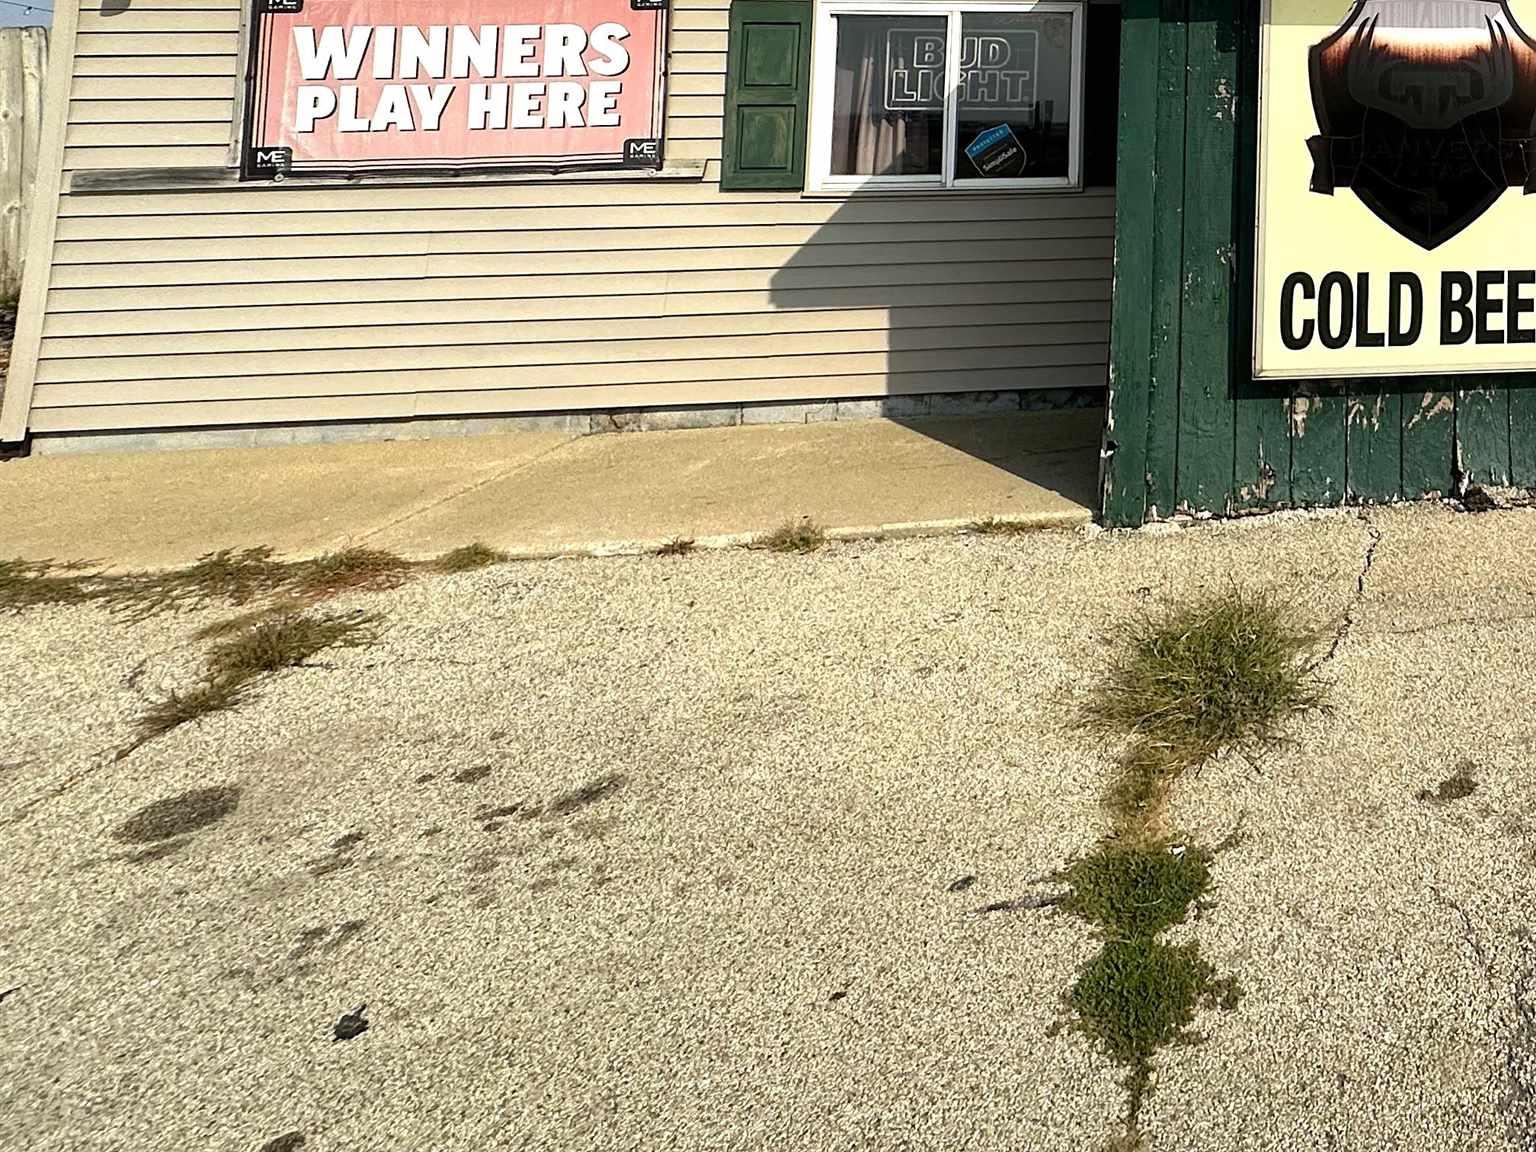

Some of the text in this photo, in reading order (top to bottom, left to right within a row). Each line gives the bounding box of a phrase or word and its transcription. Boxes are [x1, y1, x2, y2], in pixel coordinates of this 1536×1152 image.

[293, 22, 630, 79] WINNERS
[914, 36, 1011, 68] BUD
[297, 81, 622, 133] PLAY HERE
[892, 70, 1030, 102] LIGHT
[1280, 271, 1424, 350] COLD
